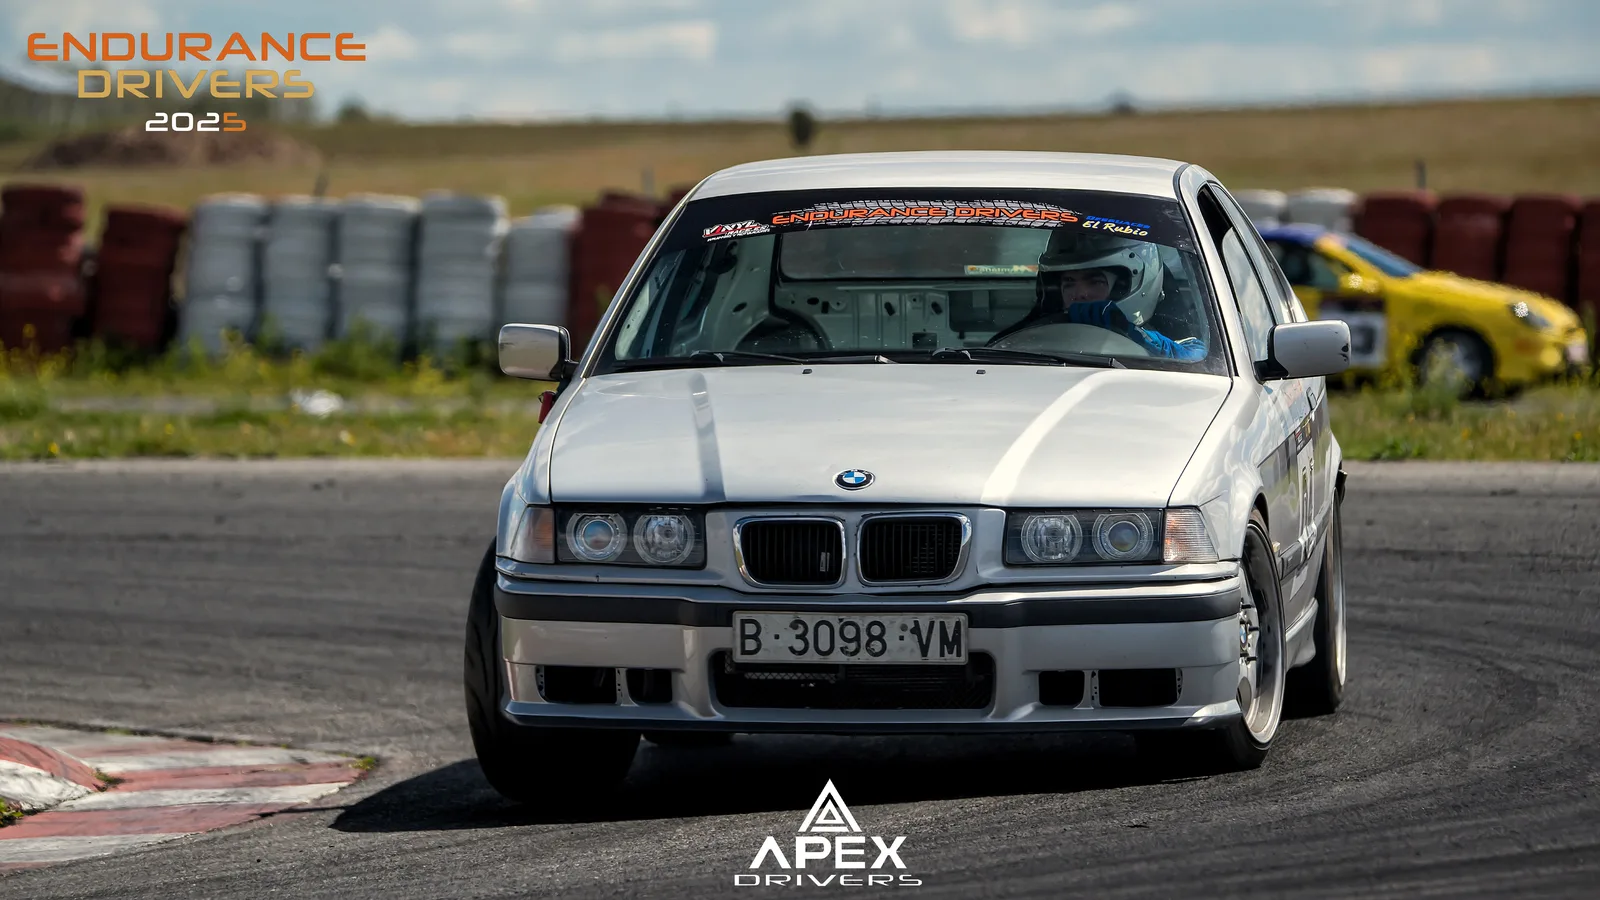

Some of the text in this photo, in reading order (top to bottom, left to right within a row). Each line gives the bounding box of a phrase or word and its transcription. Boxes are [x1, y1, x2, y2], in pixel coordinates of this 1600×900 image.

[772, 207, 1079, 225] ENDURANCE DRIVERS
[1102, 222, 1149, 237] Rubio
[740, 619, 962, 658] B 3098 VM
